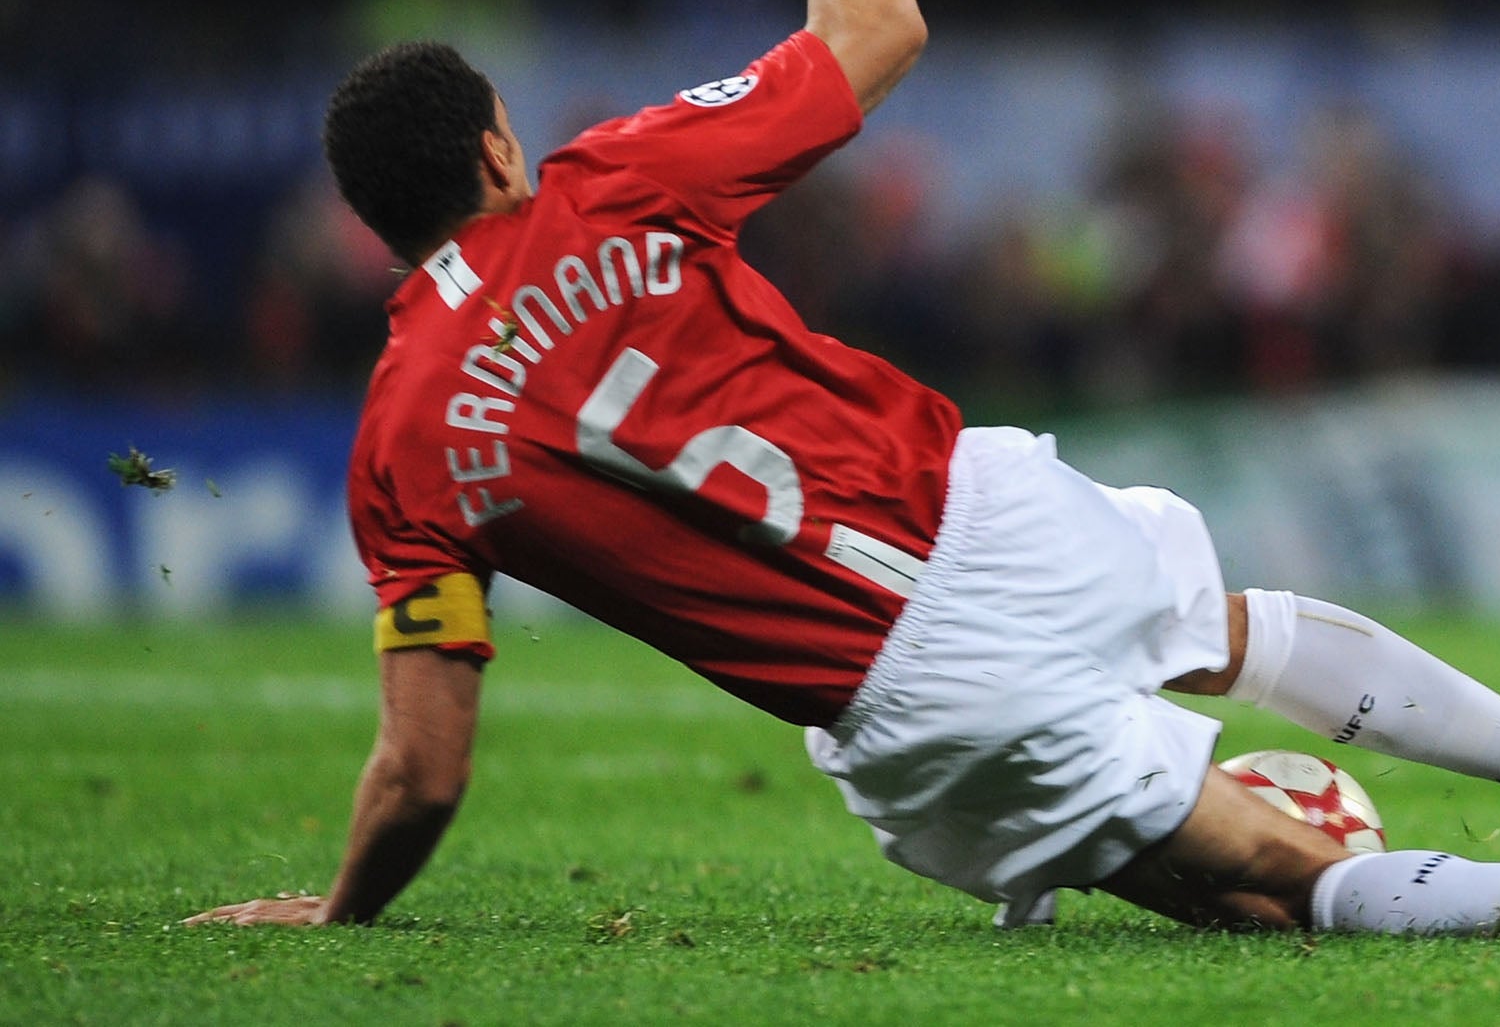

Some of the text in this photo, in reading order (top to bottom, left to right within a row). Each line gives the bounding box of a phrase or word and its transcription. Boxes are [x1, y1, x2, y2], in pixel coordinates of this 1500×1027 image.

[445, 231, 684, 527] FERDINAND
[576, 346, 805, 546] 5
[393, 583, 443, 635] C
[1331, 693, 1376, 744] UFC
